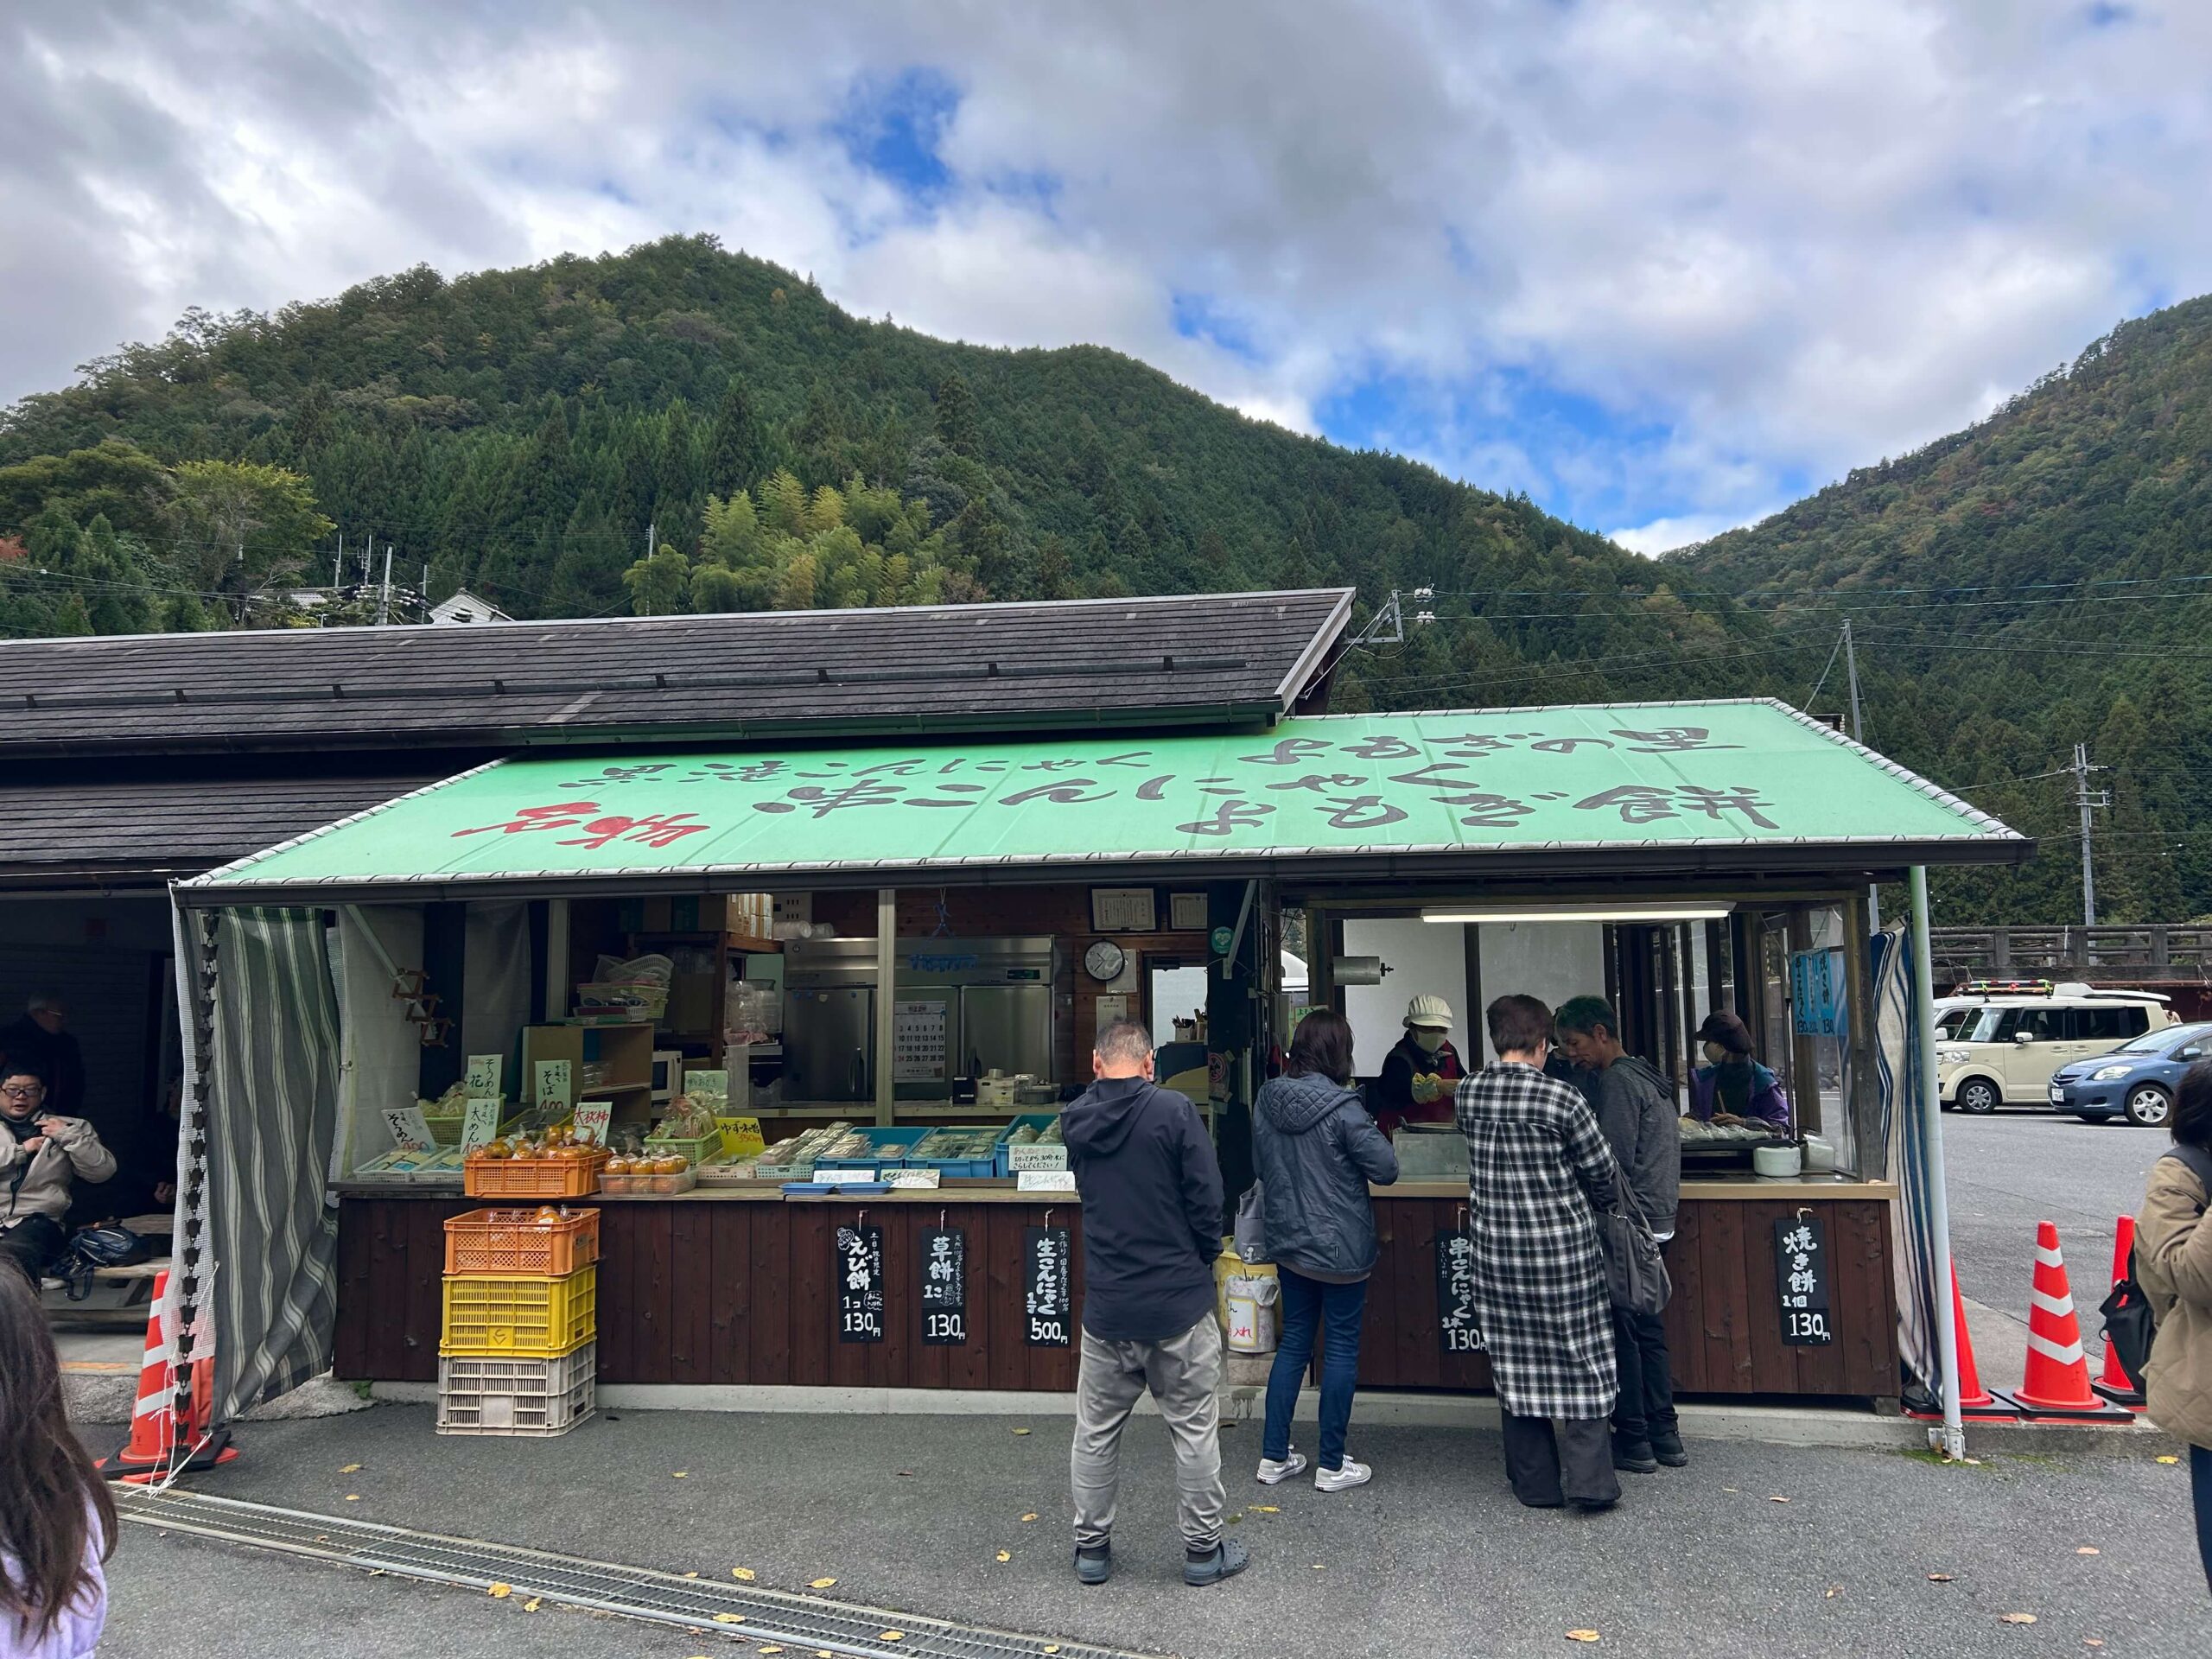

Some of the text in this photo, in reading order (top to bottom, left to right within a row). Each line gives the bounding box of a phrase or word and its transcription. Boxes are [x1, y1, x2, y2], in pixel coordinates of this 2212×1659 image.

[1237, 727, 1747, 766] よもぎの里
[450, 800, 711, 850] 名物
[1174, 784, 1781, 836] よもぎ餅
[543, 1070, 556, 1096] そば
[847, 1236, 873, 1291] えび餅
[929, 1236, 954, 1281] 草餅
[1036, 1237, 1057, 1315] 生こんにゃく
[1449, 1237, 1471, 1319] 串こんにゃく
[1783, 1225, 1817, 1294] 焼き餅
[1783, 1295, 1808, 1307] 1個
[843, 1313, 880, 1337] 130円
[927, 1314, 965, 1340] 130円
[1031, 1317, 1067, 1344] 500円
[1789, 1313, 1831, 1341] 130円
